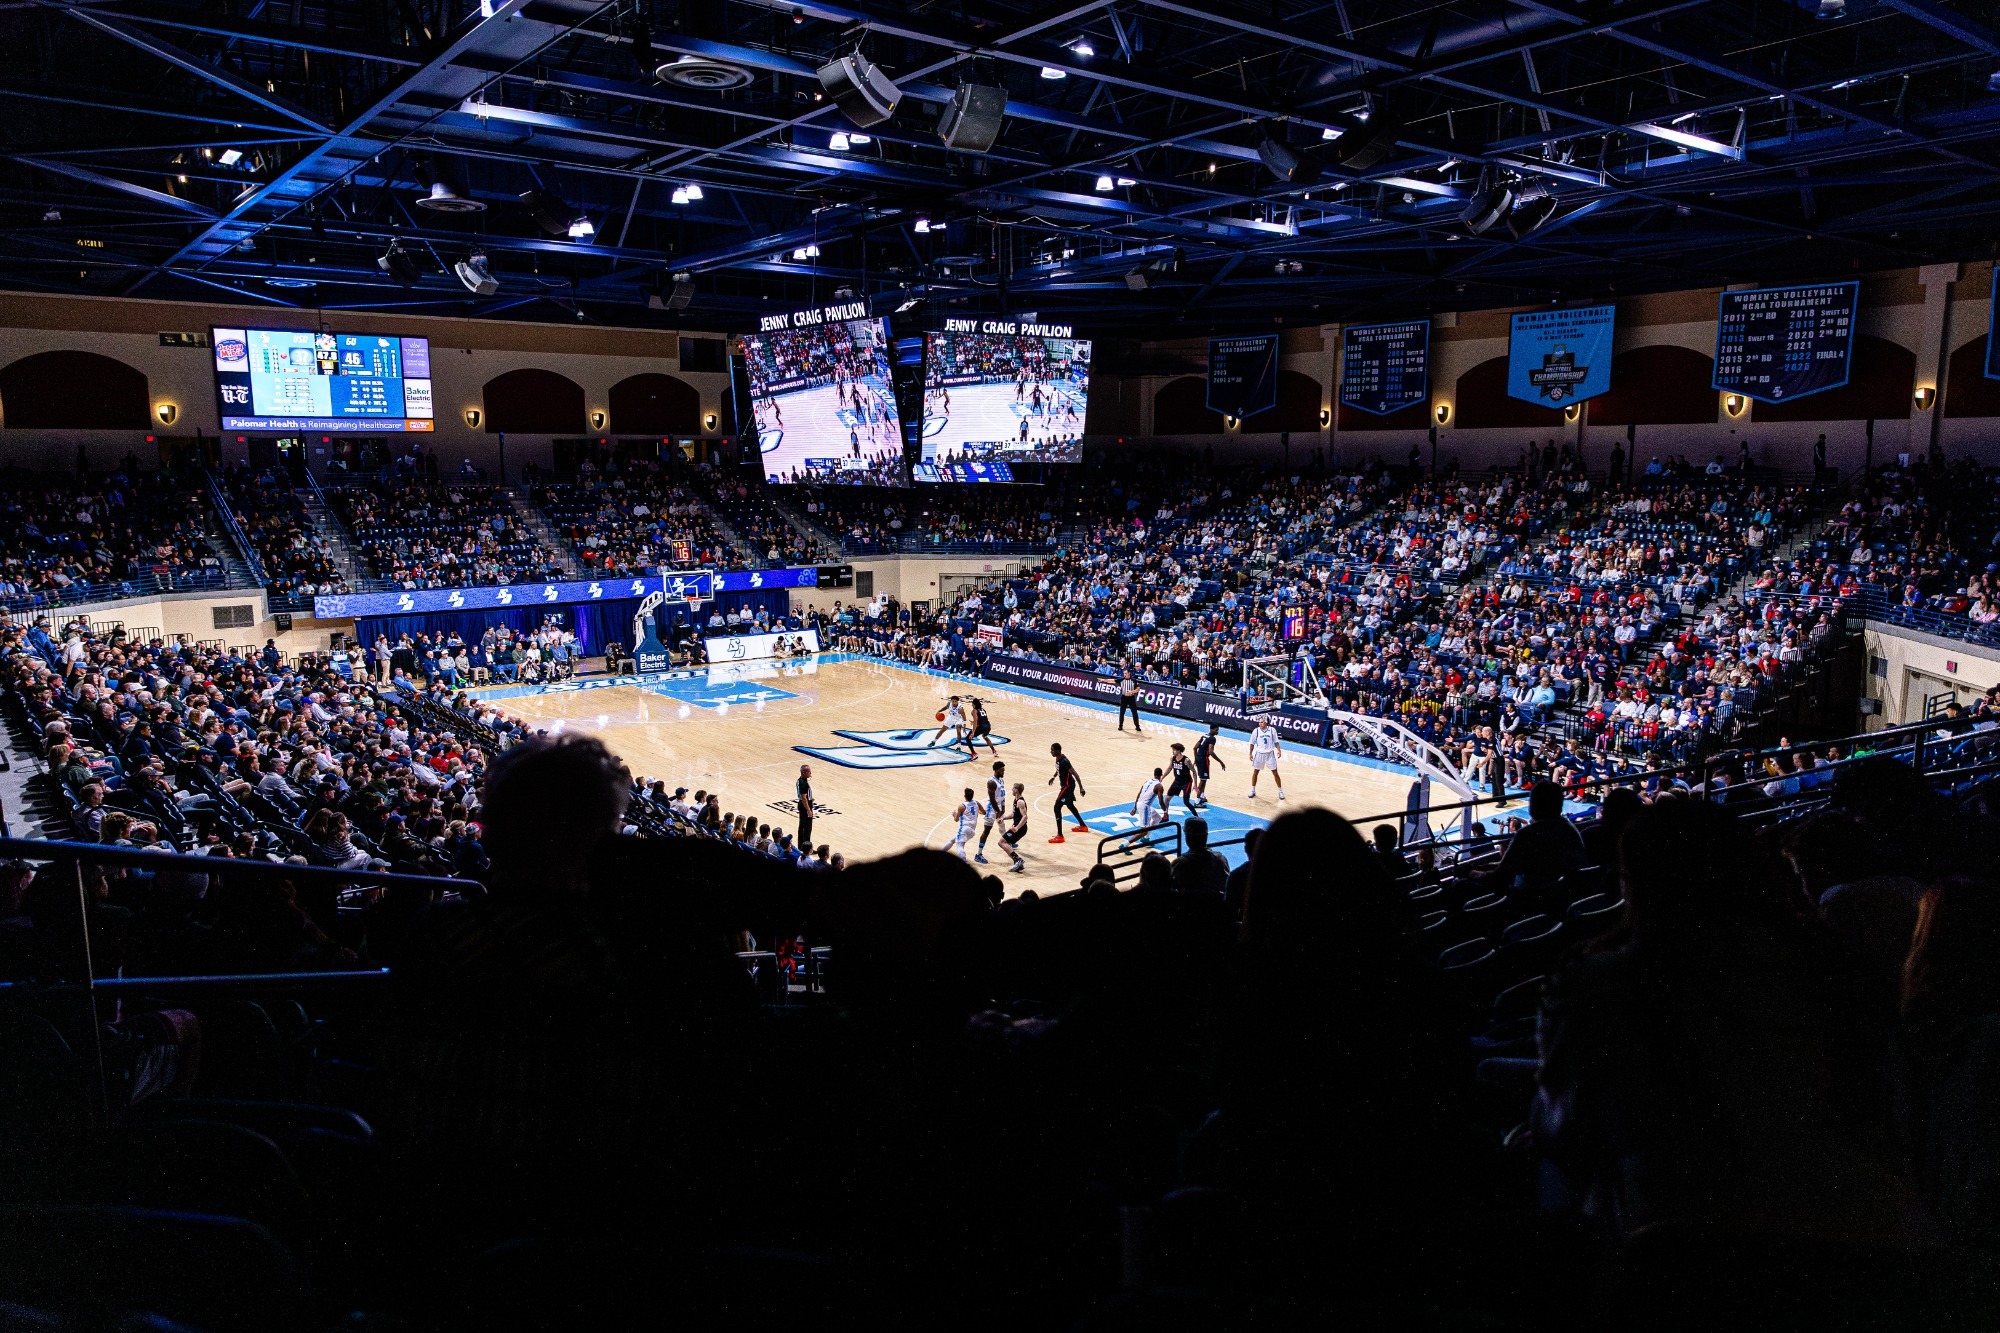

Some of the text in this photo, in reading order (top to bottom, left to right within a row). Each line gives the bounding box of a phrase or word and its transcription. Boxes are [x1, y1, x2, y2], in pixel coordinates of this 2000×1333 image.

[1734, 288, 1844, 302] WOMEN'S VOLLEYBALL
[1742, 298, 1832, 311] NCAA TOURNAMENT
[761, 302, 866, 331] JENNY CRAIG PAVILION
[1518, 309, 1609, 322] WOMEN'S VOLLEYBALL
[1724, 314, 1746, 323] 2011
[1790, 309, 1815, 318] 2018
[945, 319, 1072, 337] JENNY CRAIG PAVILION
[1352, 325, 1421, 336] WOMEN'S VOLLEYBALL
[1722, 324, 1746, 333] 2012
[1788, 331, 1814, 340] 2020
[1787, 341, 1812, 350] 2021
[345, 352, 360, 365] 46
[1816, 351, 1837, 360] FINAL
[1533, 371, 1584, 382] CHAMPIONSHIP
[309, 420, 357, 430] Reimagining
[680, 548, 688, 558] 16
[1291, 618, 1302, 636] 16
[979, 628, 1002, 642] ESPN
[640, 653, 666, 662] Baker
[991, 663, 1122, 695] FOR ALL YOUR AUDIOVISUAL NEEDS
[1136, 688, 1182, 710] FORTÉ
[1349, 716, 1380, 740] UNIVERSITY
[1388, 743, 1401, 754] SAN
